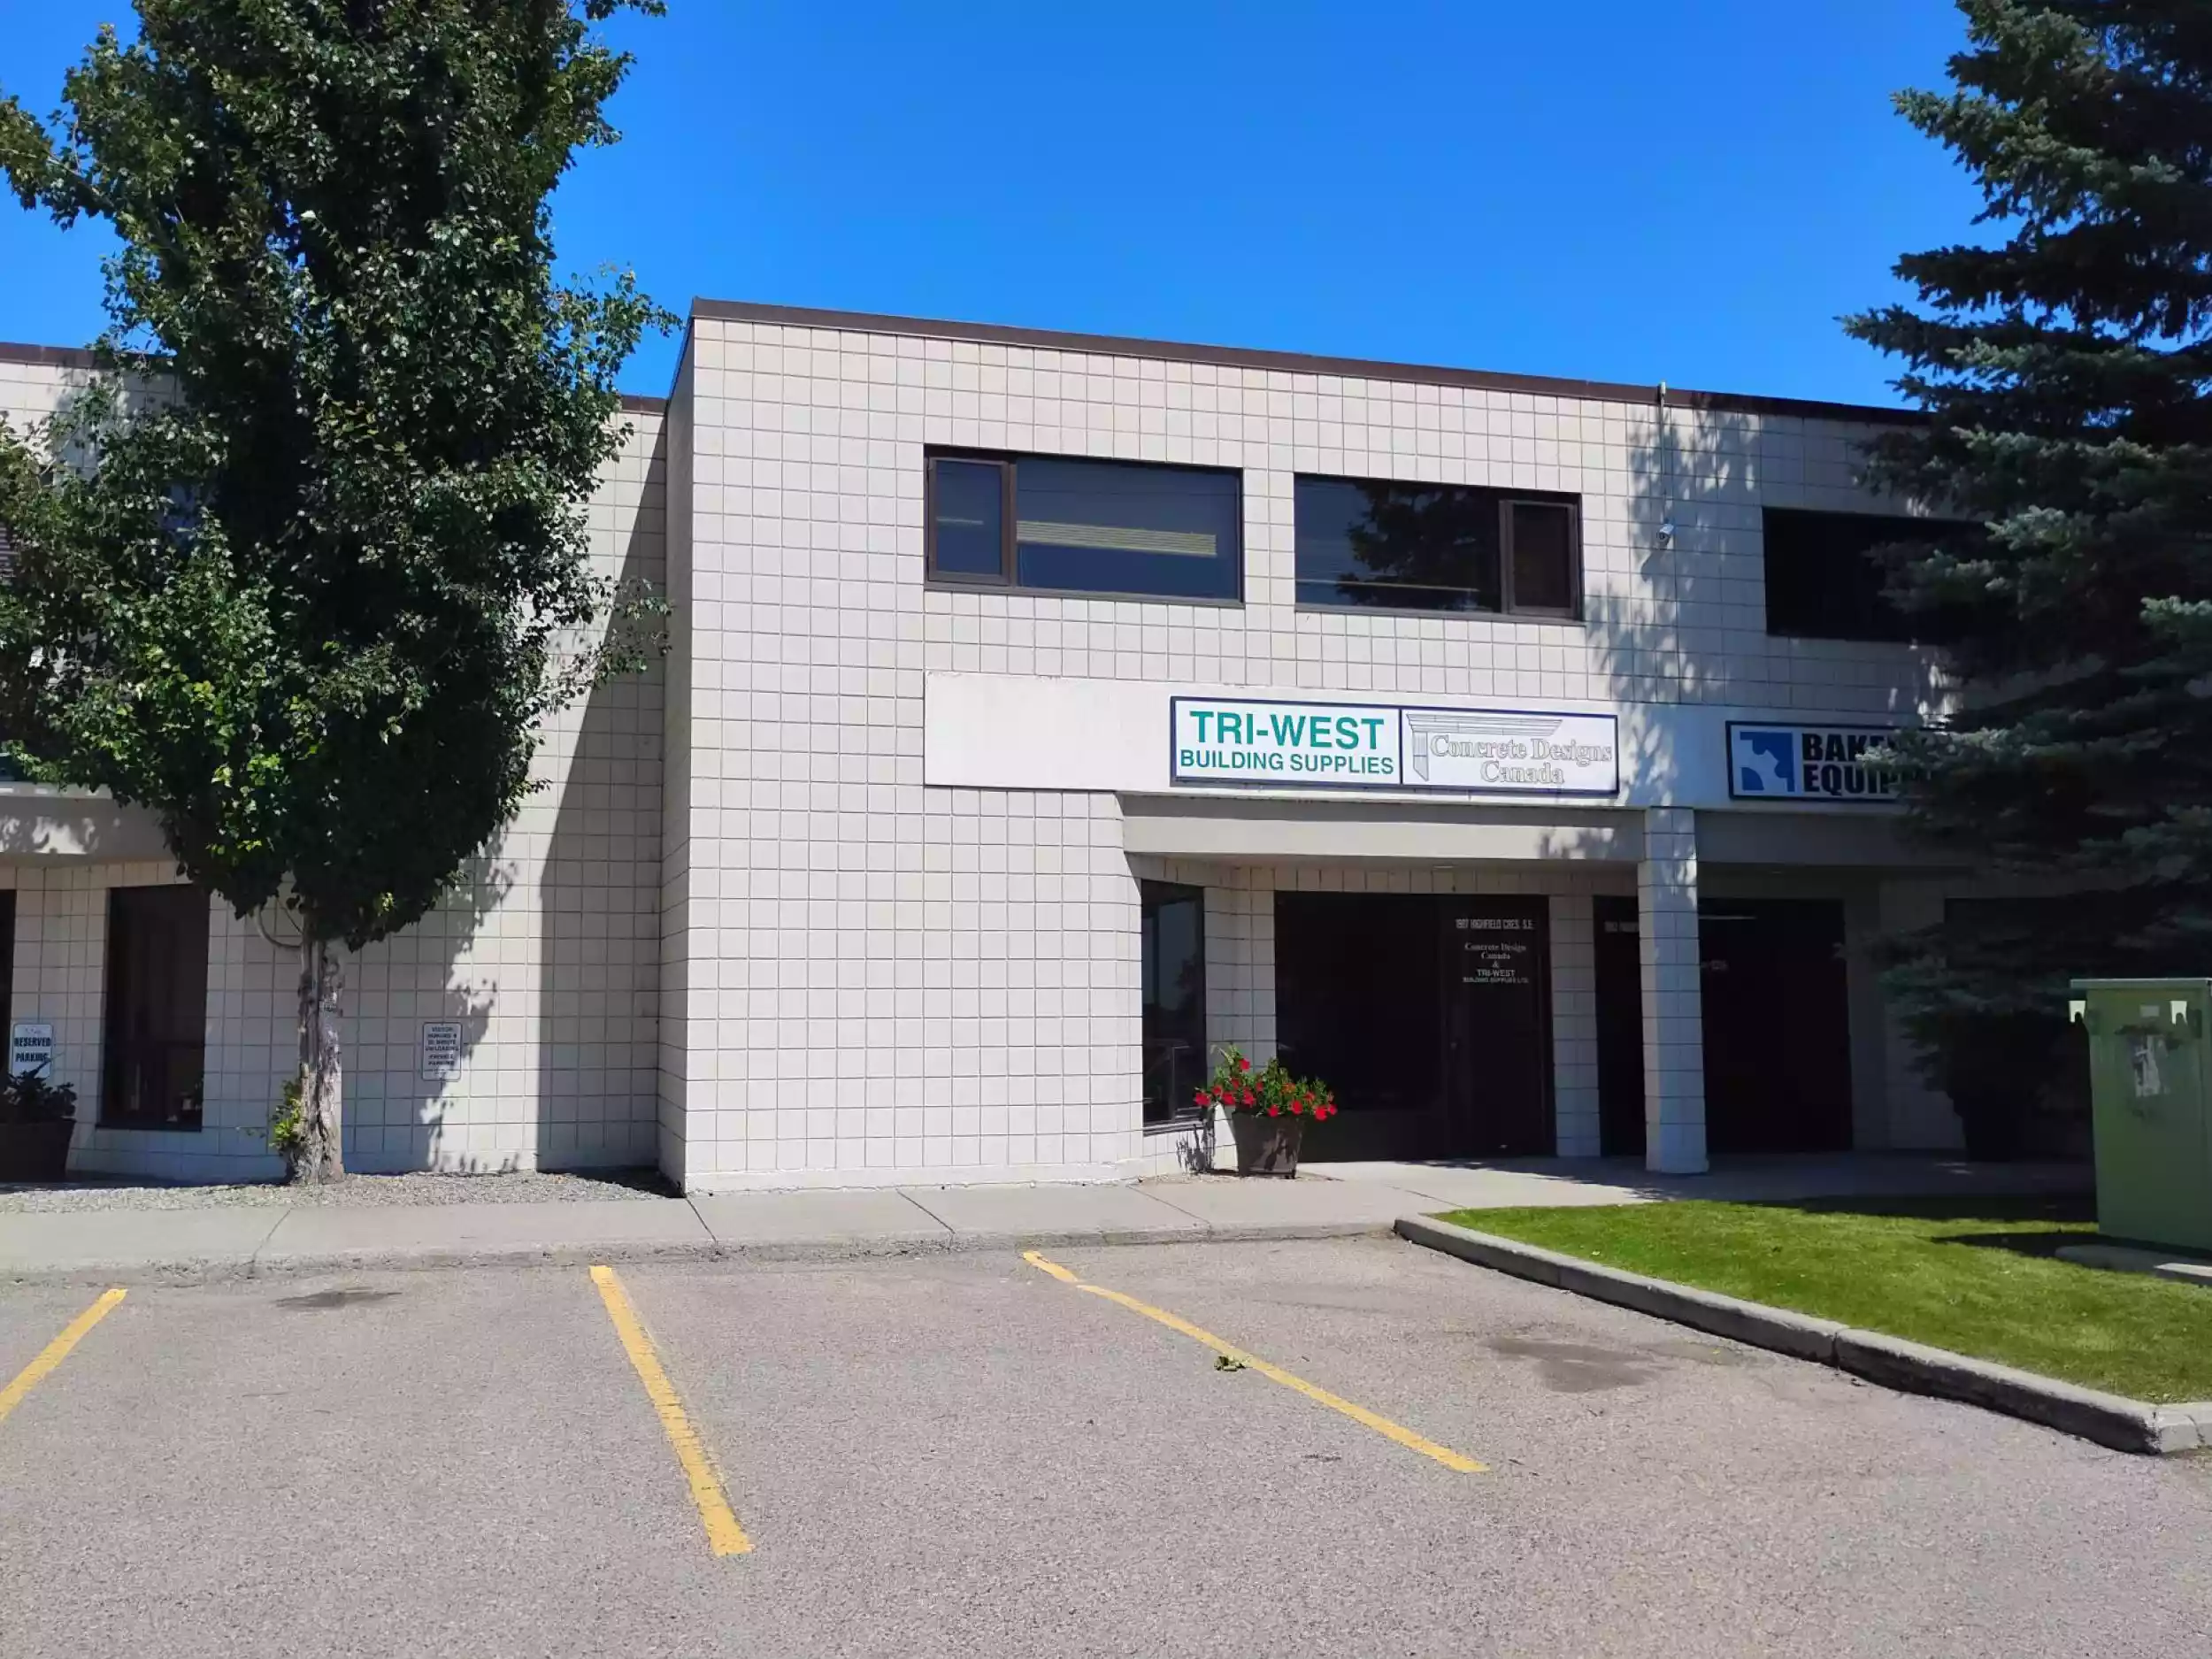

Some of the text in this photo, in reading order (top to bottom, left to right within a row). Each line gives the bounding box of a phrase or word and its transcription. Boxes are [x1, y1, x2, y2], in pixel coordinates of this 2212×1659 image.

[1189, 710, 1385, 750] TRI-WEST
[1429, 735, 1612, 766] Concrete Designs
[1802, 733, 1895, 762] BAK
[1180, 749, 1394, 775] BUILDING SUPPLIES
[1480, 761, 1565, 785] Canada
[14, 1037, 51, 1047] RESERVED
[16, 1052, 49, 1062] PARKING
